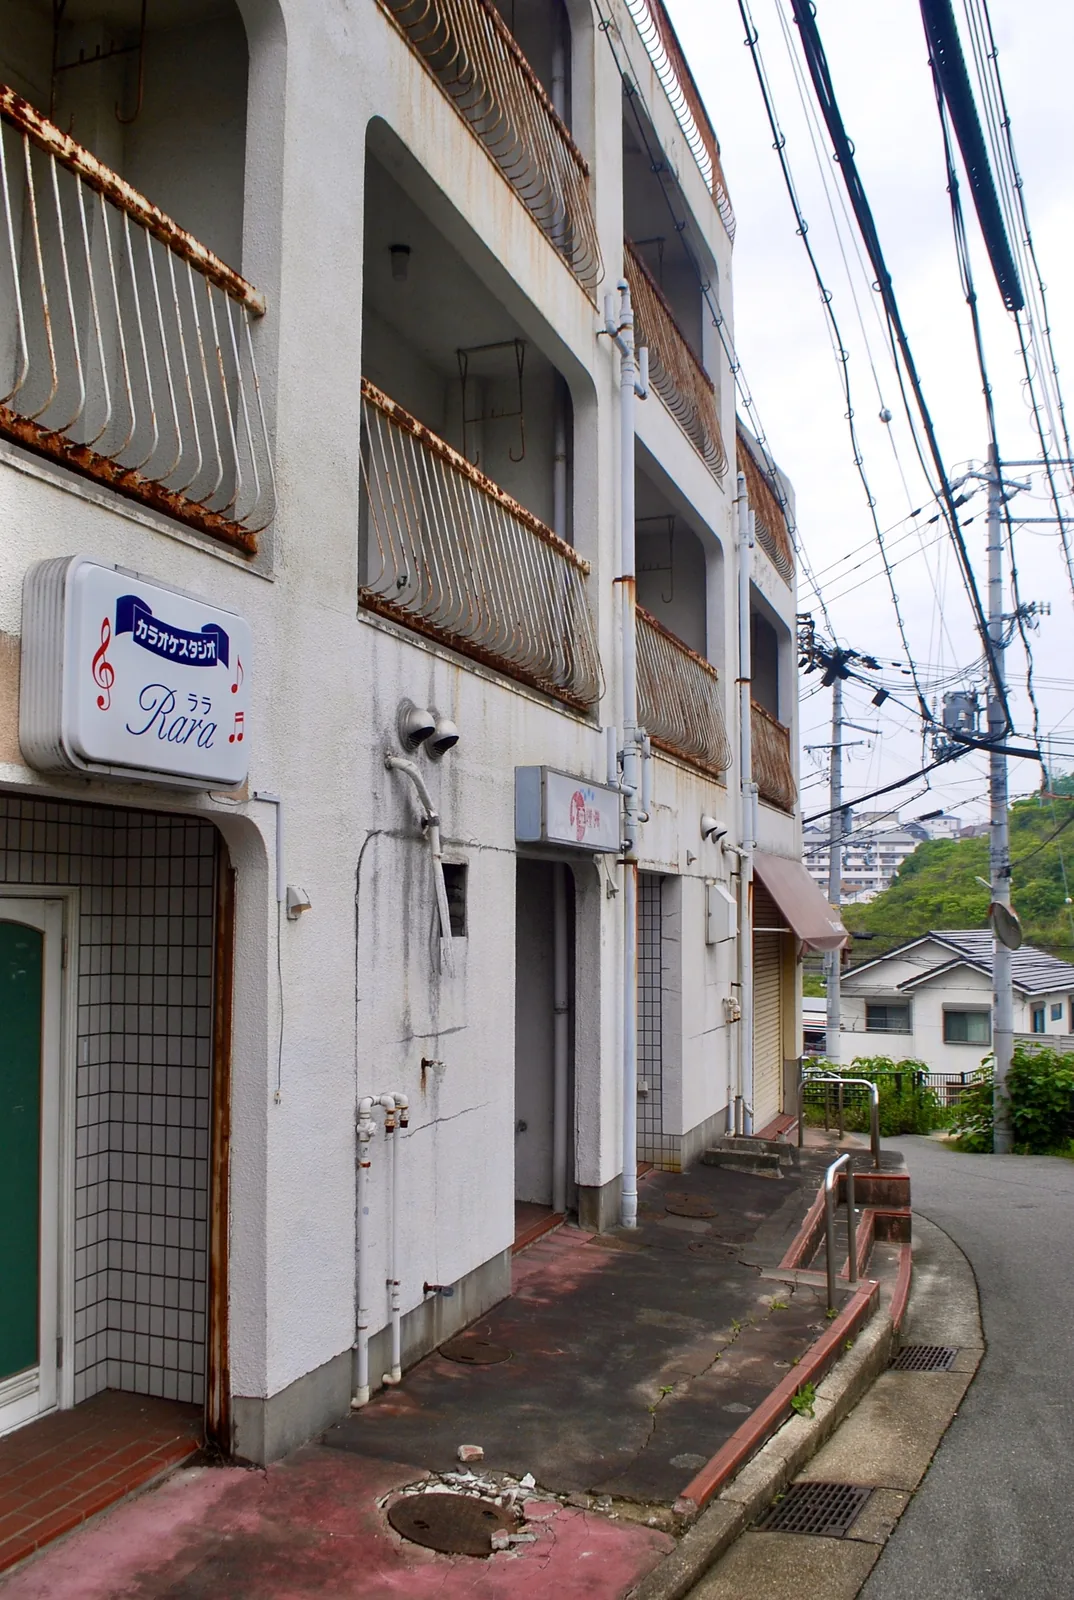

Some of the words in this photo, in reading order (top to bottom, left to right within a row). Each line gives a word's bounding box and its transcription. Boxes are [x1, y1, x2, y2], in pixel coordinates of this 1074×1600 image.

[135, 618, 216, 660] カラオケスタジオ
[125, 683, 218, 749] Rara
[187, 693, 212, 715] ララ
